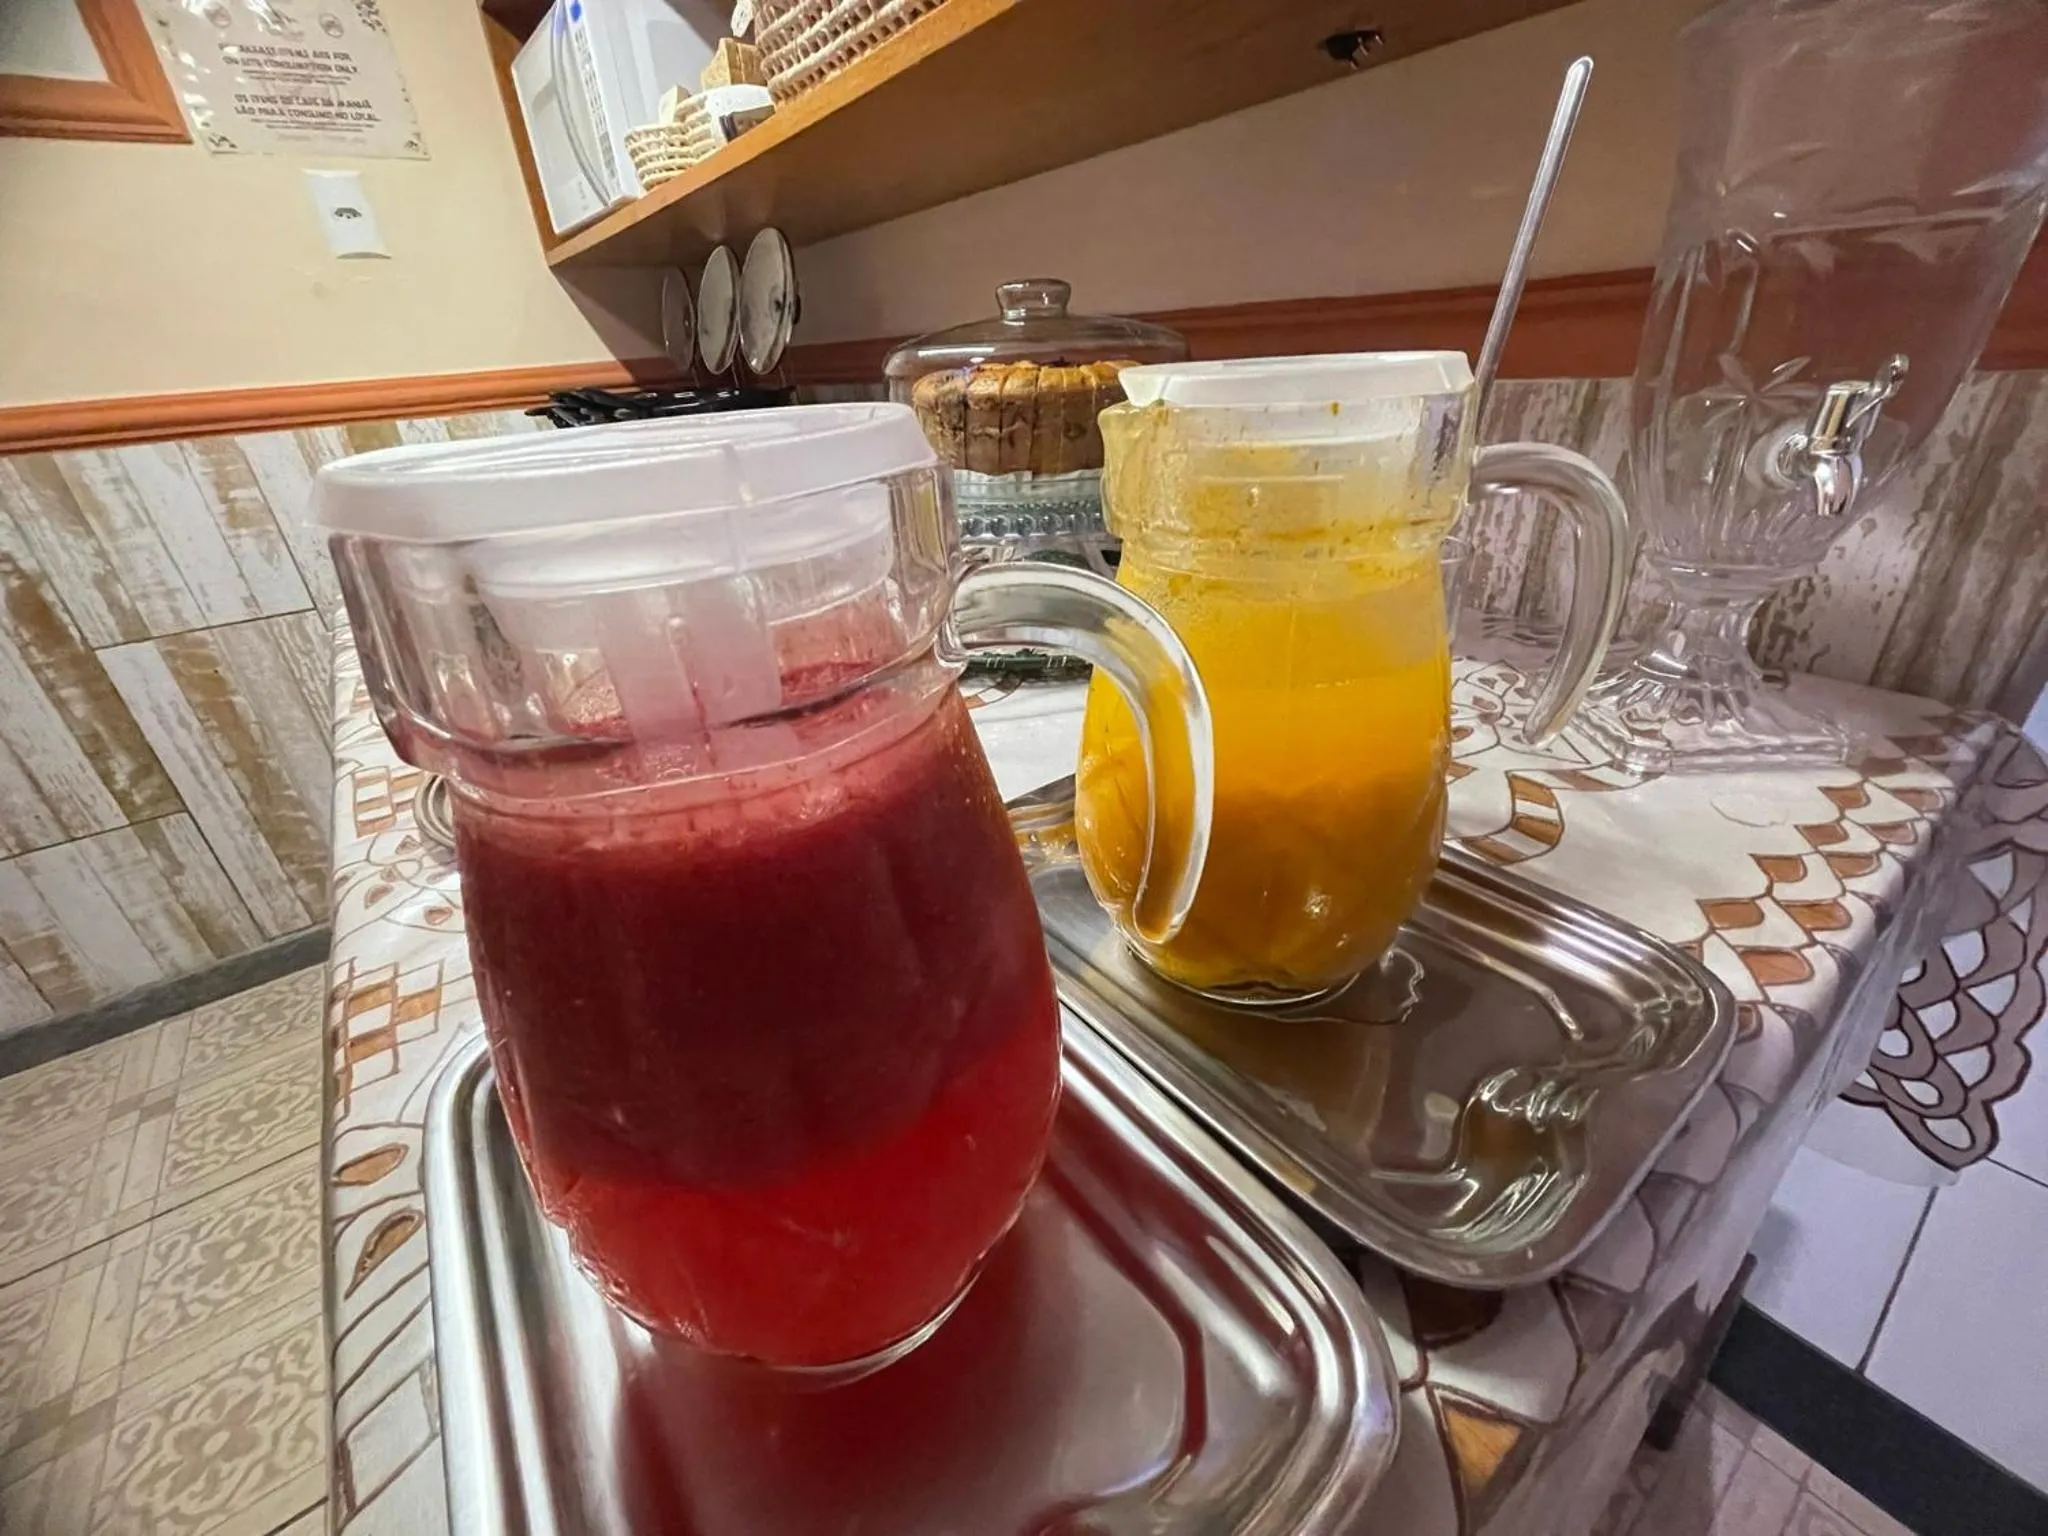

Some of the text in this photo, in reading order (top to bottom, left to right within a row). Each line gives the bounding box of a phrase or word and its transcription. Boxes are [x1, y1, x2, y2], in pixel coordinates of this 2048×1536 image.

[313, 49, 331, 59] ARE
[333, 51, 352, 61] FOR
[264, 58, 332, 72] CONSUMPTION
[334, 63, 358, 73] ONLY
[288, 109, 333, 119] CONSUMO
[335, 111, 349, 119] NO
